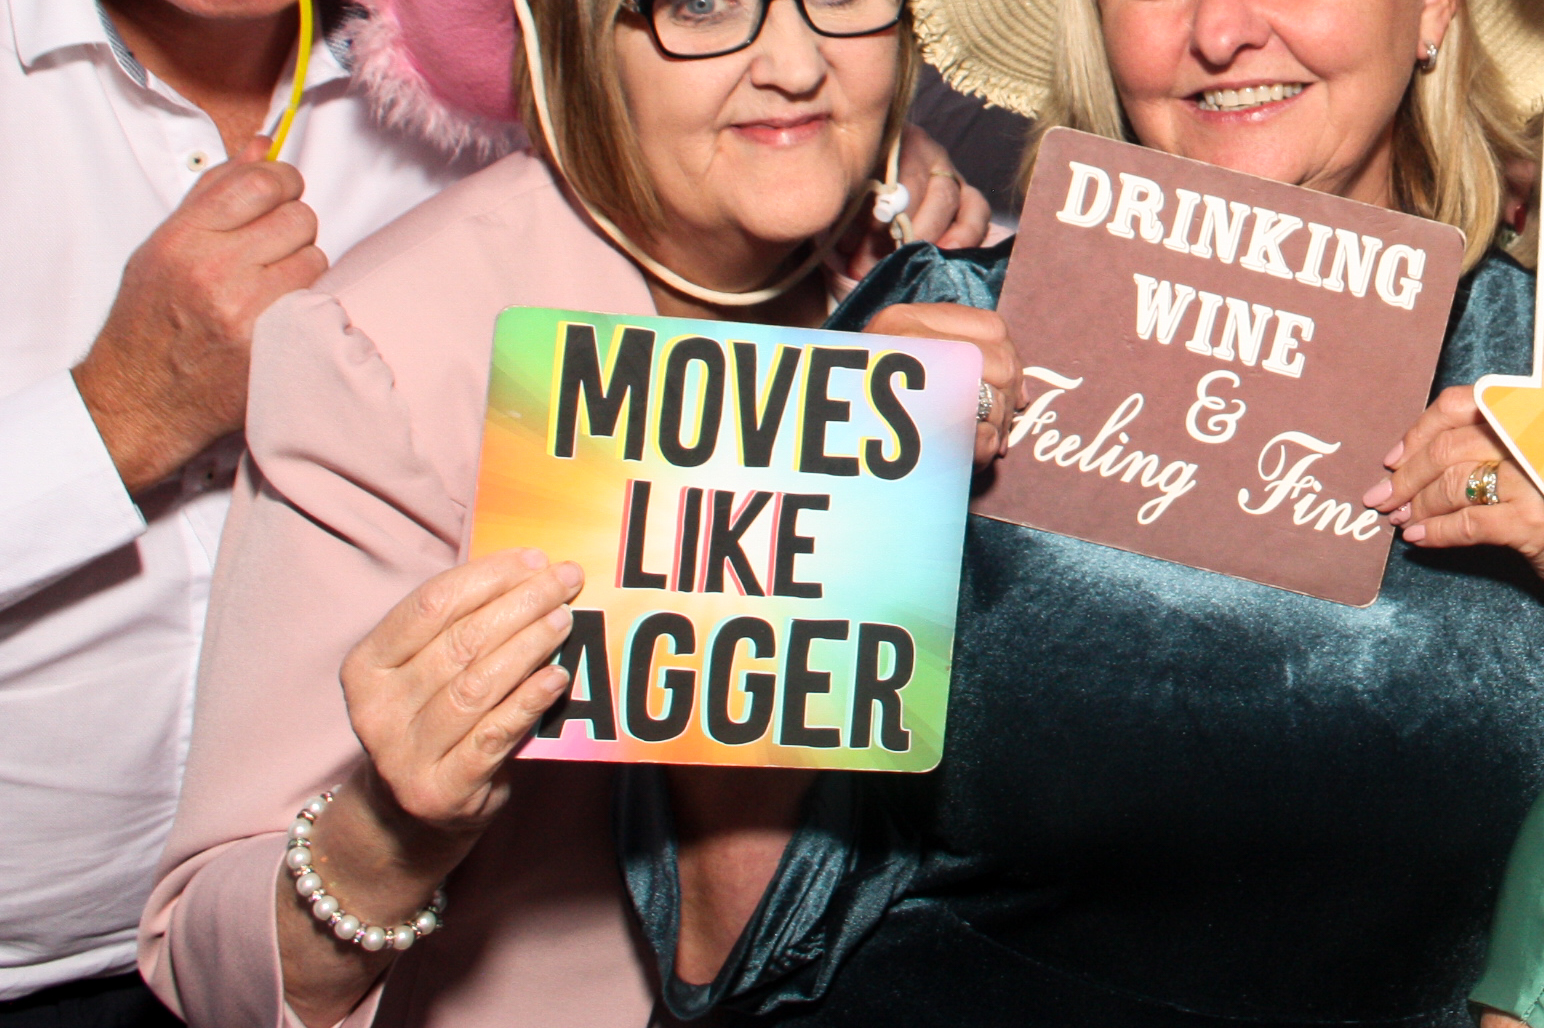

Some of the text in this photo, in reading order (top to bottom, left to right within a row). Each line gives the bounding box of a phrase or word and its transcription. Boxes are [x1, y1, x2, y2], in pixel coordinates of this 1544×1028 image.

[1056, 161, 1426, 310] DRINKING
[1133, 273, 1315, 378] WINE
[547, 321, 926, 480] MOVES
[1008, 366, 1381, 540] Feeling Fine
[1185, 370, 1246, 443] &
[614, 479, 830, 598] LIKE
[536, 609, 915, 752] AGGER
